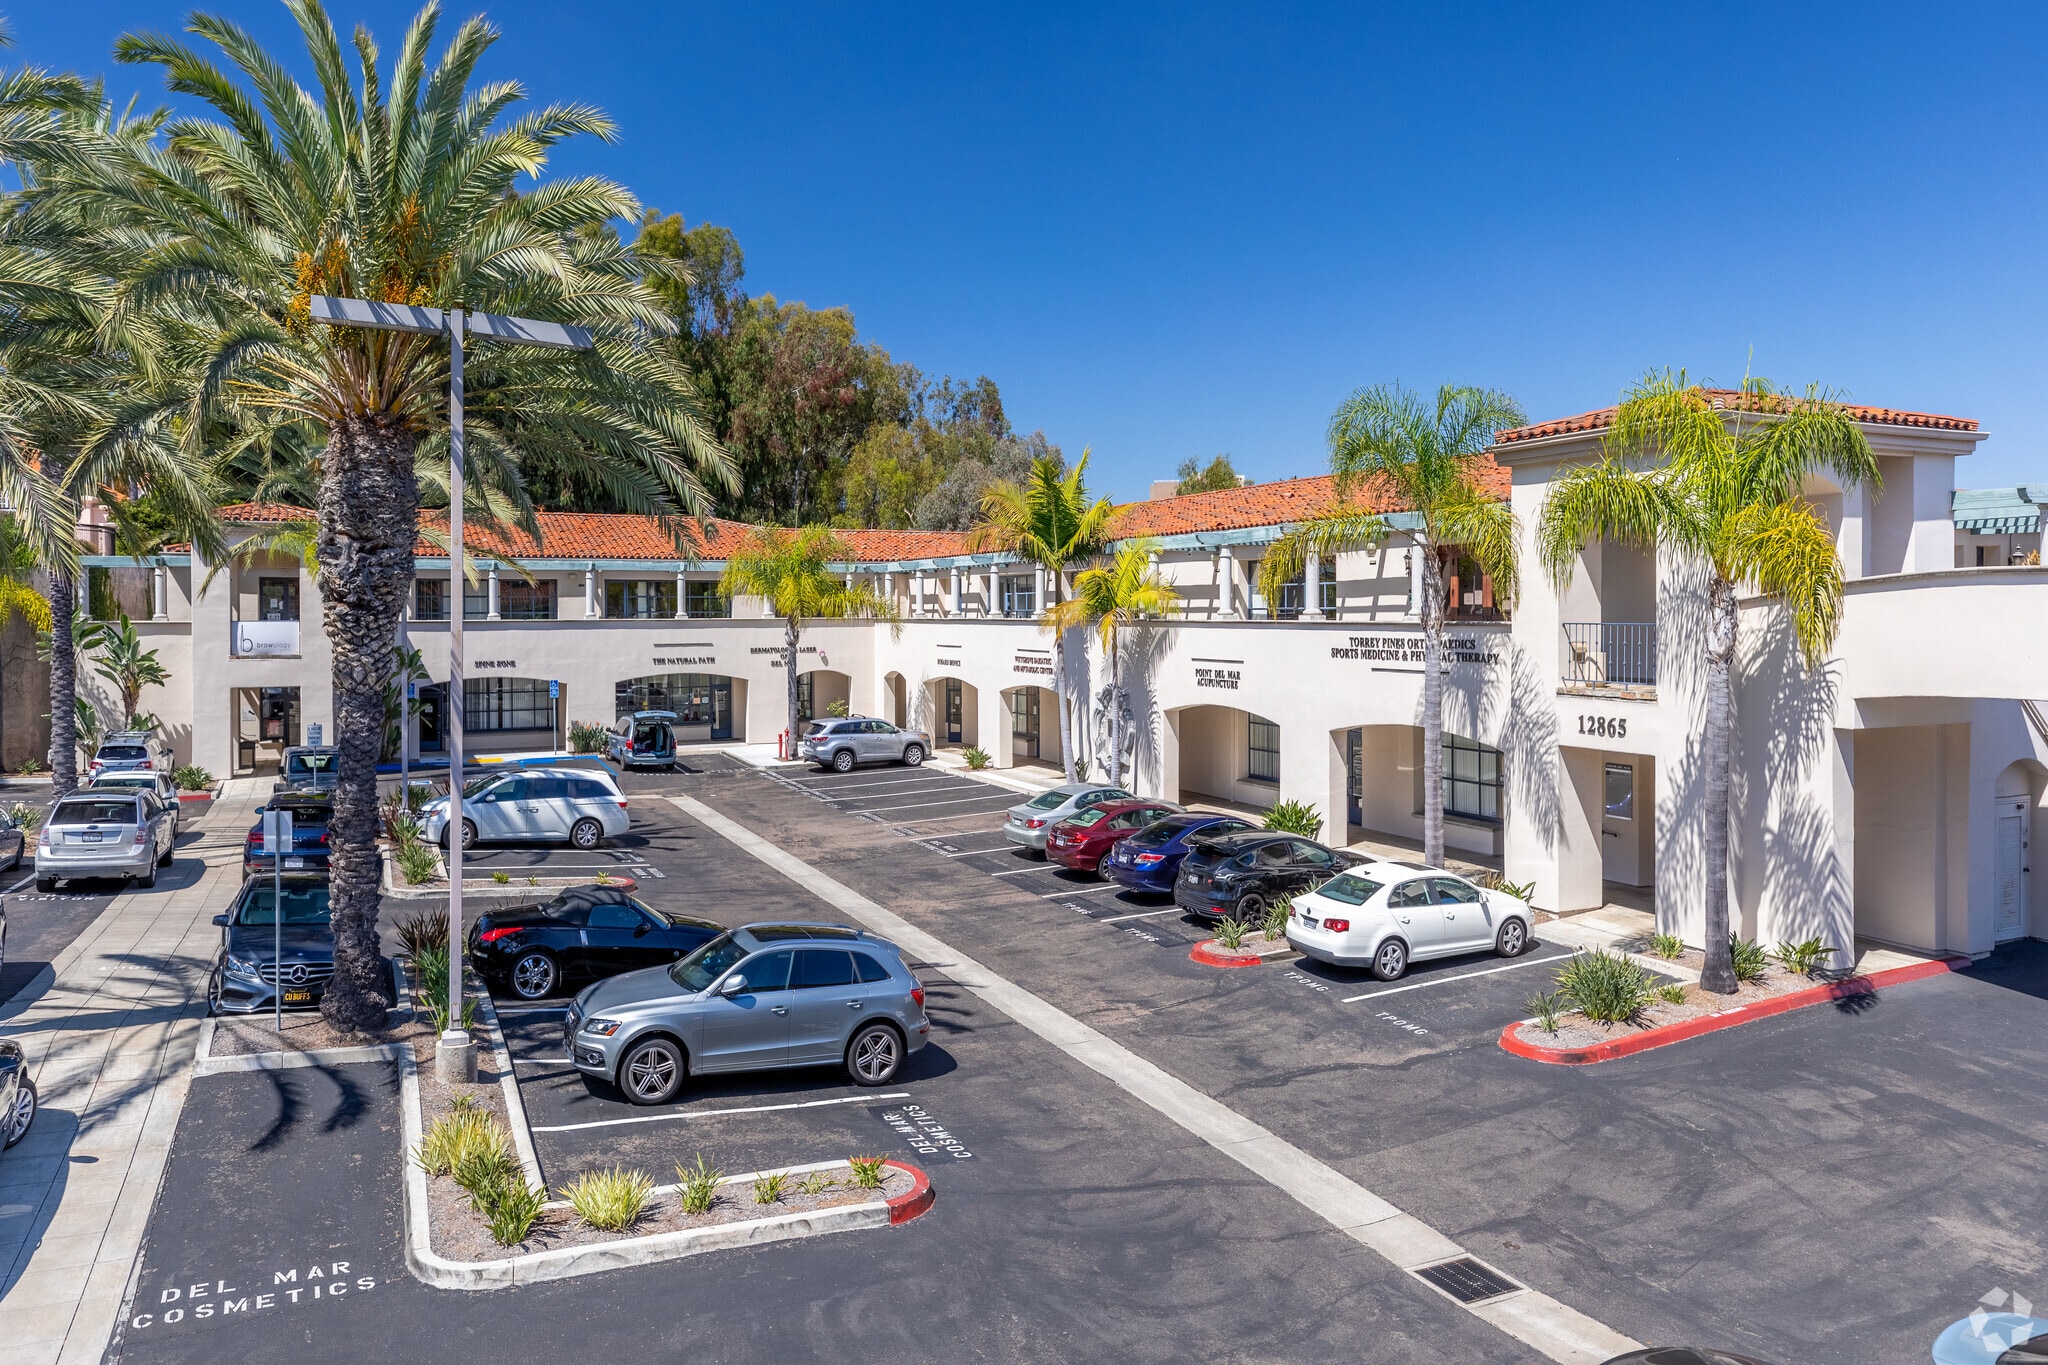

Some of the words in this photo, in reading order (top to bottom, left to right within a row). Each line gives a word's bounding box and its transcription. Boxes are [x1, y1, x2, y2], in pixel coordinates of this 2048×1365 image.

[256, 642, 291, 651] browology
[1349, 637, 1380, 648] TORREY
[1382, 638, 1406, 650] PINES
[1407, 638, 1476, 650] ORTAEDICS
[667, 657, 698, 666] NATURAL
[698, 657, 716, 665] PATH
[1331, 648, 1359, 660] SPORTS
[1360, 649, 1400, 661] MEDICINE
[1401, 650, 1409, 662] &
[1455, 652, 1500, 665] THERAPY
[1195, 668, 1212, 678] POINT
[1214, 669, 1226, 679] DEL
[1228, 670, 1241, 680] MAR
[1197, 677, 1239, 690] ACUPUNCTURE
[1578, 714, 1627, 739] 12865
[1283, 971, 1329, 992] TPOMG
[1375, 1012, 1429, 1035] TPOMG
[883, 1113, 918, 1135] MAR
[902, 1104, 973, 1159] COSMETICS
[906, 1134, 939, 1154] DEL
[160, 1279, 237, 1304] DEL
[273, 1261, 351, 1286] MAR
[132, 1276, 377, 1330] COSMETICS
